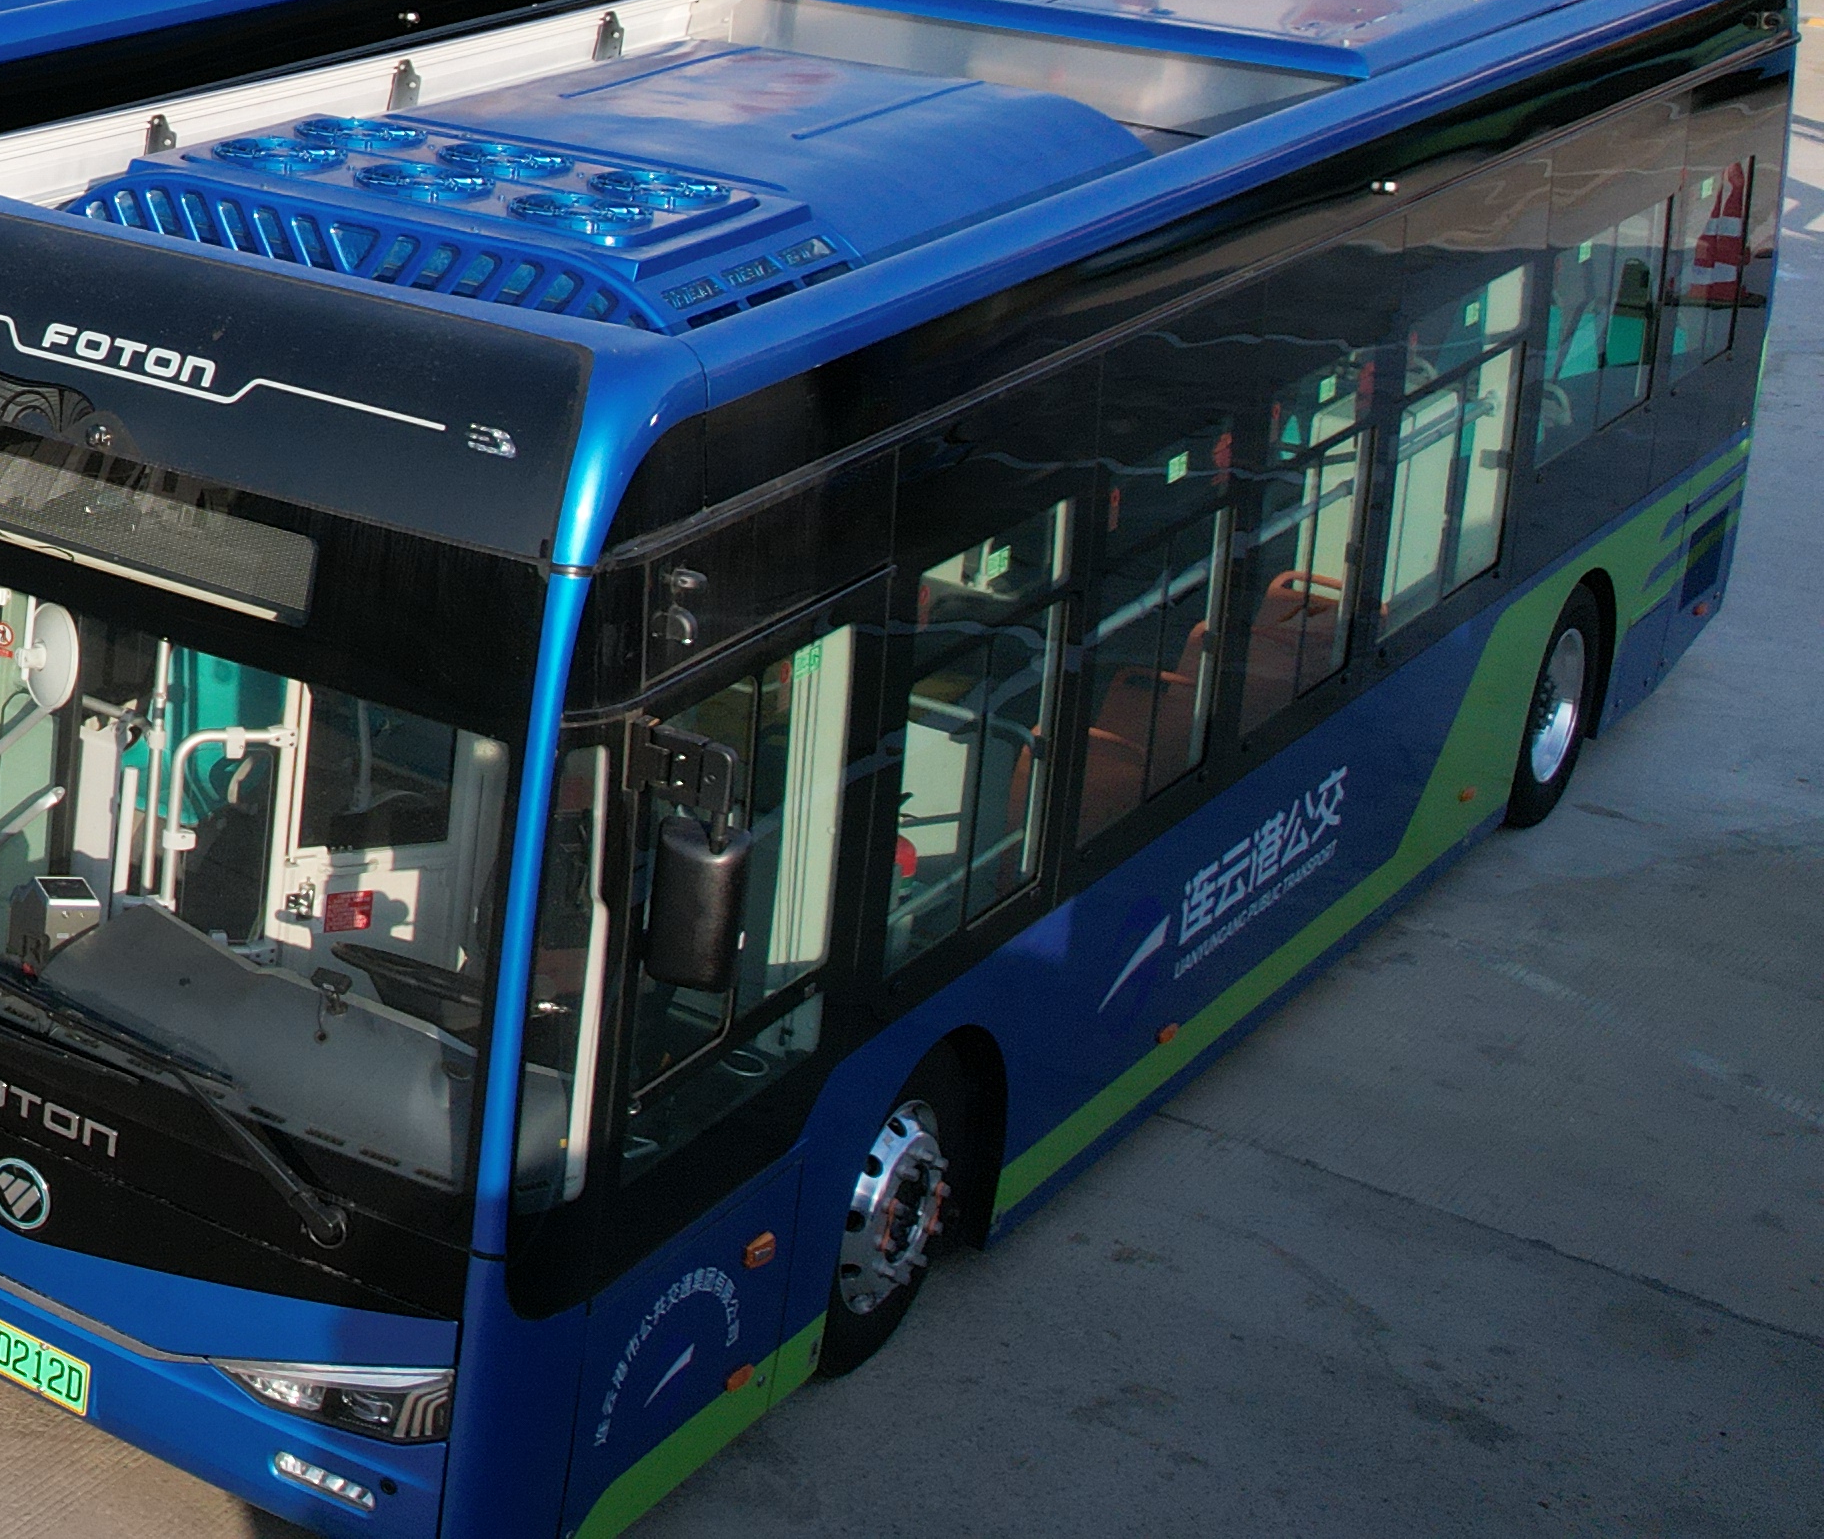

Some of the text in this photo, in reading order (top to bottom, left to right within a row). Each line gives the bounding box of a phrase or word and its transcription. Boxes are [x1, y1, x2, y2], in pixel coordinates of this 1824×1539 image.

[41, 323, 216, 389] FOTON
[1179, 766, 1348, 946] 连云港公交
